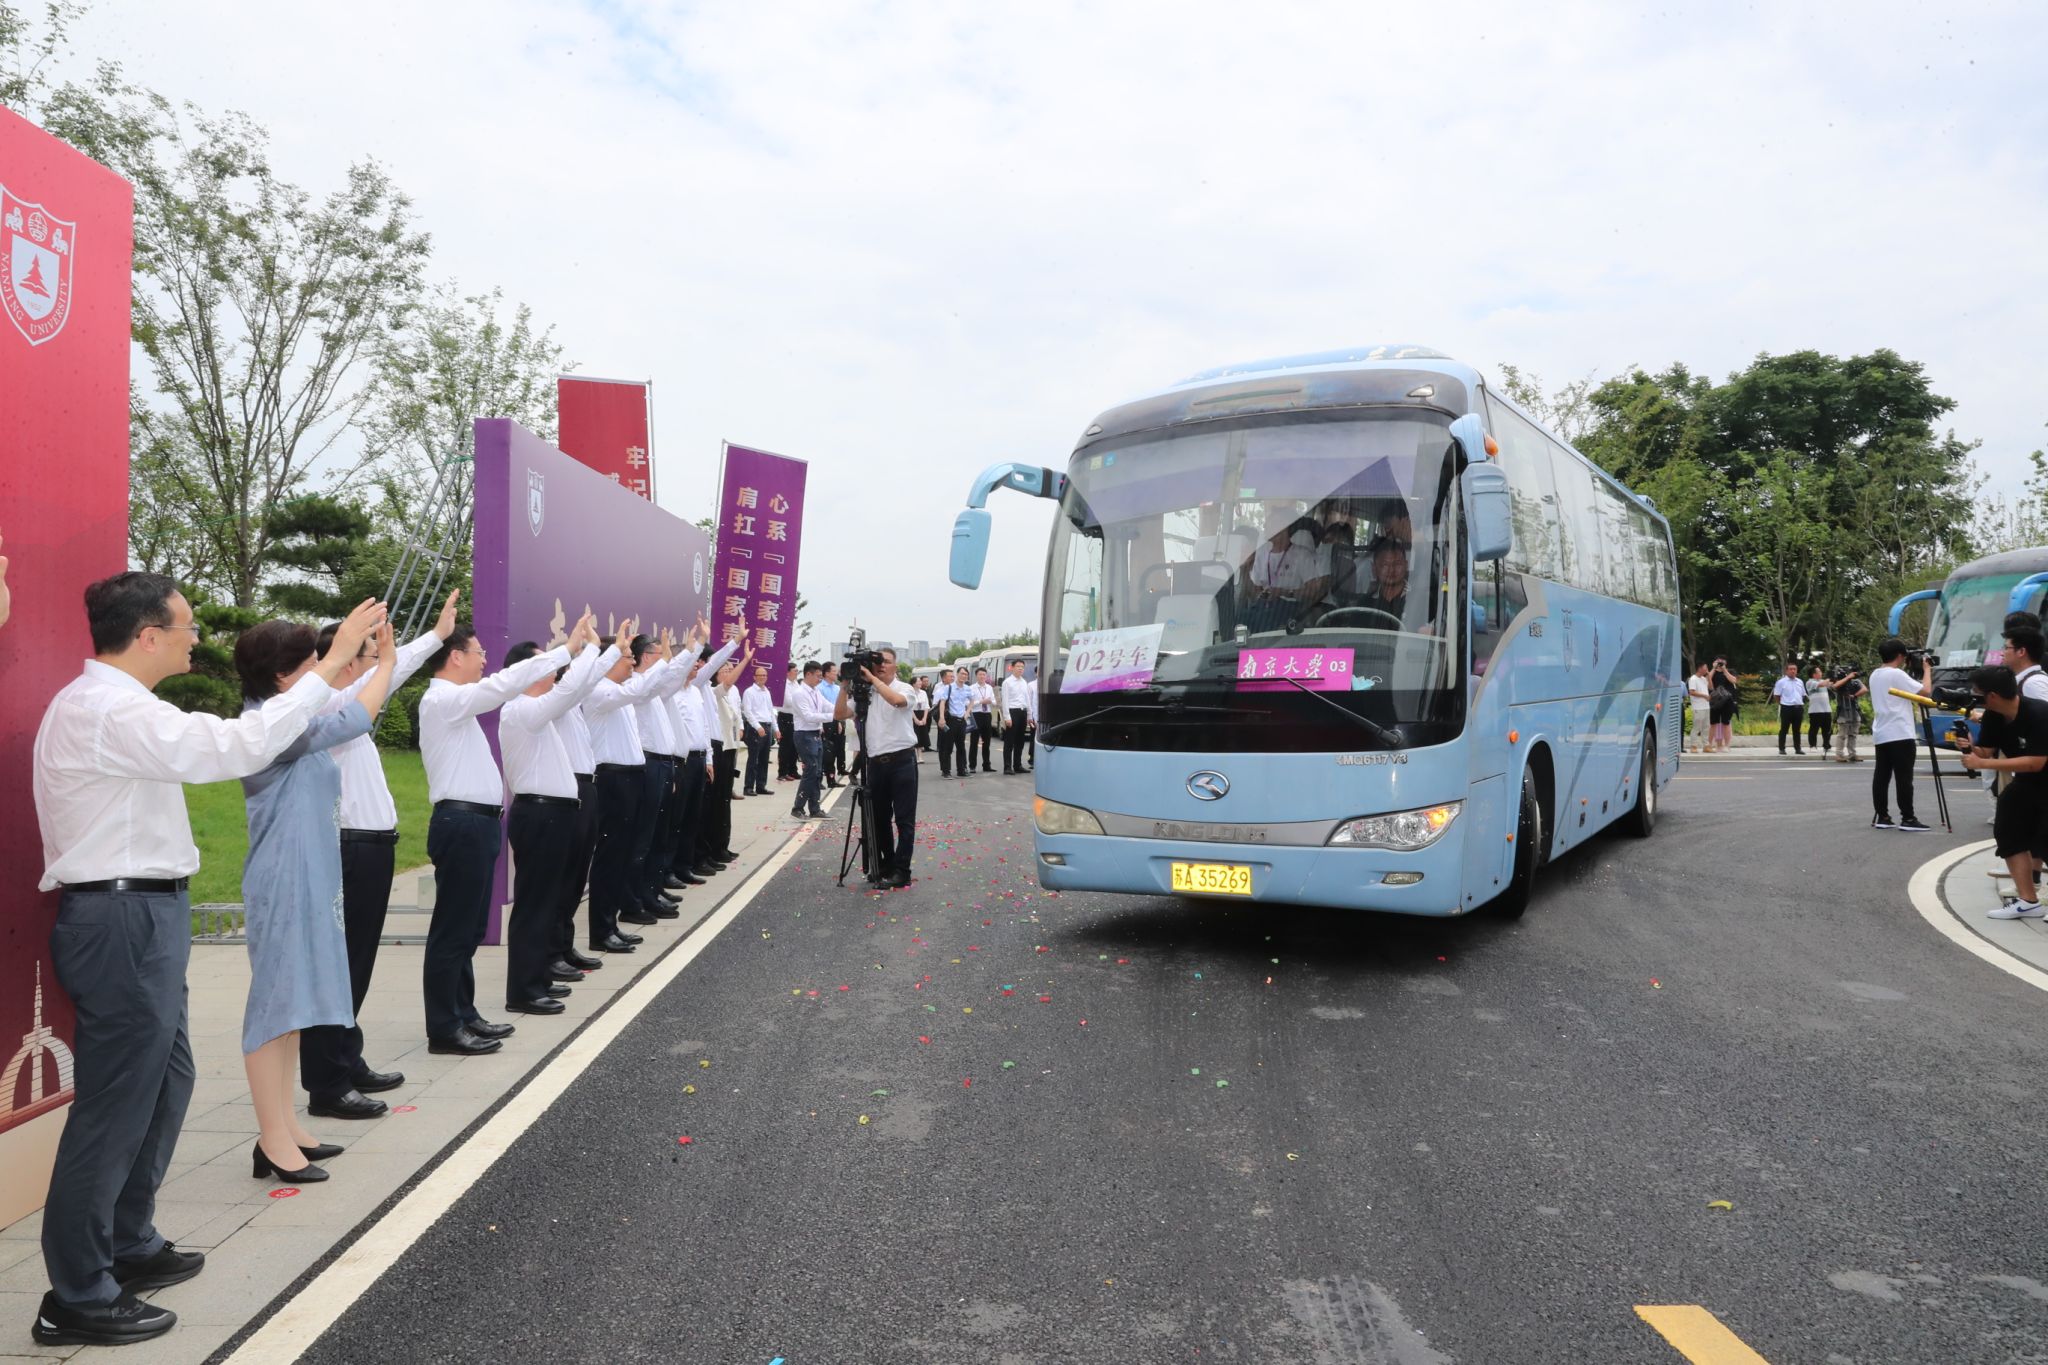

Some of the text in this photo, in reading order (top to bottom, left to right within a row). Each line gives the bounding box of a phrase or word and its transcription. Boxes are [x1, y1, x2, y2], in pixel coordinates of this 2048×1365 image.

[1, 252, 68, 336] NANJING UNIVERSITY
[1075, 645, 1150, 673] 02号车
[1329, 660, 1347, 673] 03
